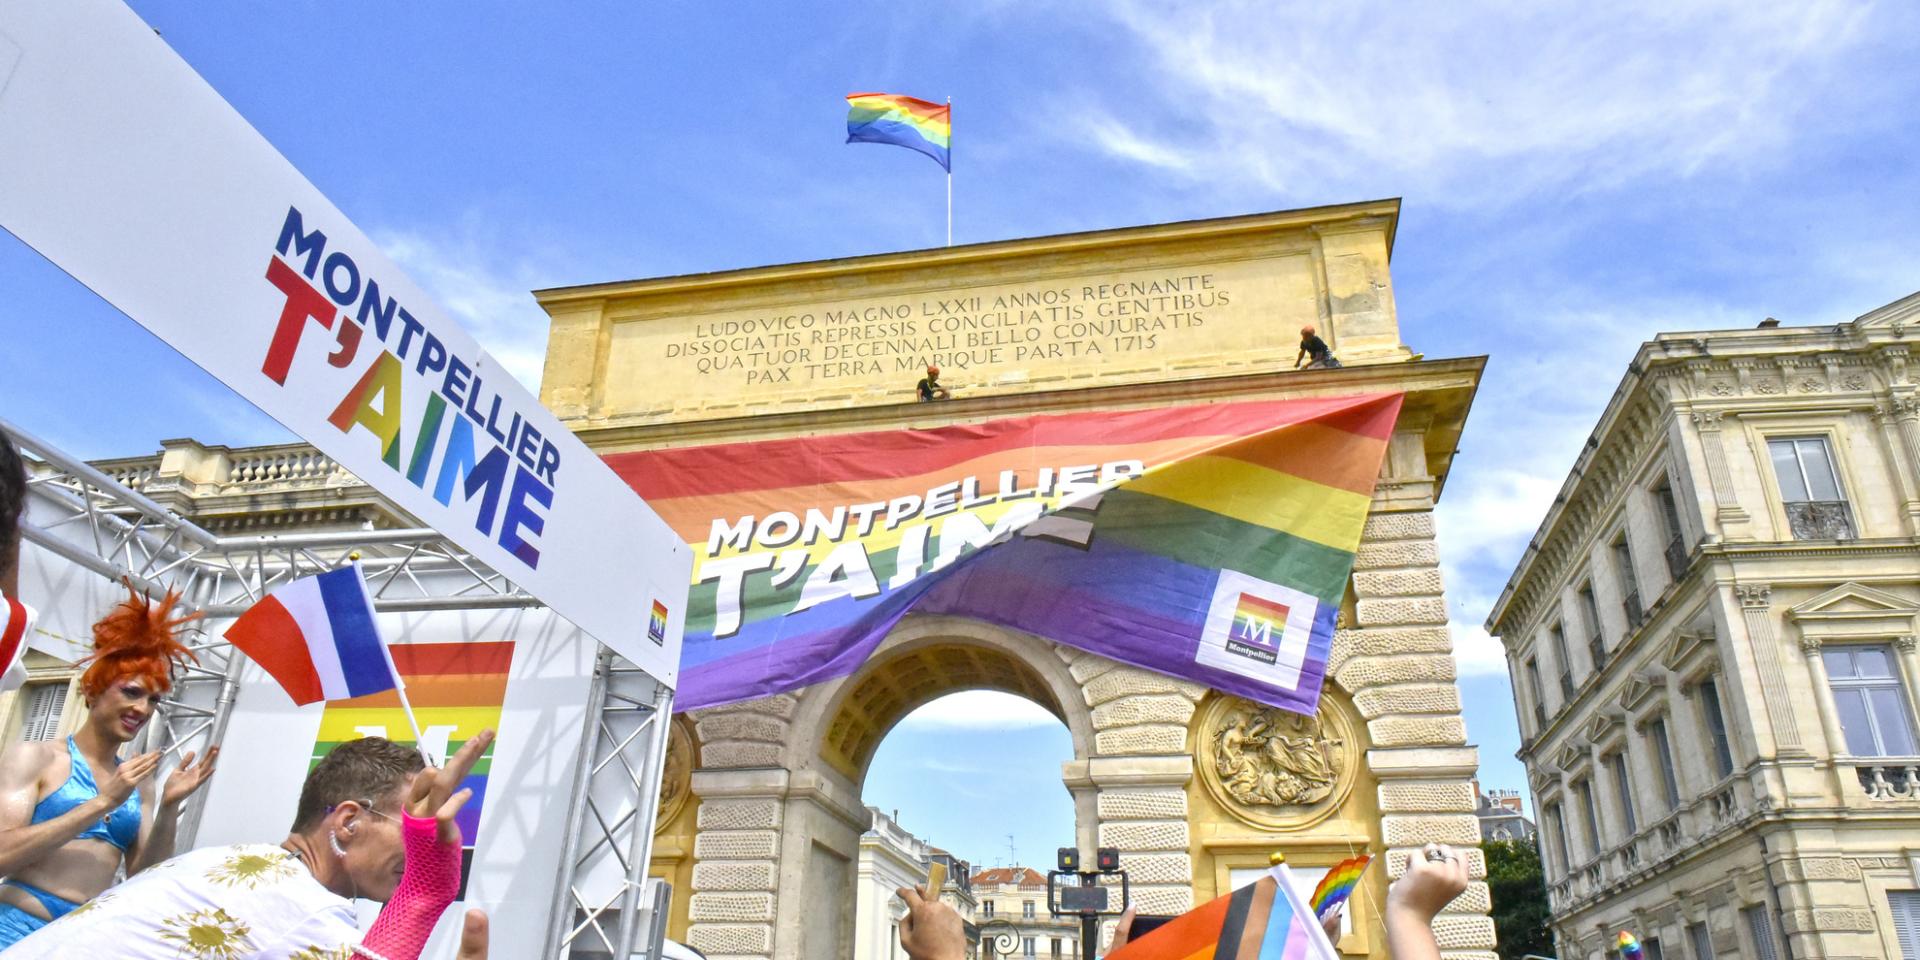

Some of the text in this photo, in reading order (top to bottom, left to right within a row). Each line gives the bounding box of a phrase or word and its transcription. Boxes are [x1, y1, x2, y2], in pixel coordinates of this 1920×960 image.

[666, 290, 1230, 358] DISSOCIATIS REPRESSIS CONCILIATIS GENTIBUS
[696, 274, 1215, 338] LUDOVICO MAGNO LXXII ANNOS REGNANTE
[275, 205, 561, 487] MONTPELLIER
[696, 311, 1204, 375] QUATUOR DECENNALI BELLO CONJURATIS
[746, 333, 1158, 385] PAX TERRA MARIQUE PARTA 1715
[261, 254, 554, 571] T'AIME
[708, 459, 1146, 557] MONTPELLIER
[1228, 642, 1275, 662] Montpellier
[1239, 614, 1273, 647] M
